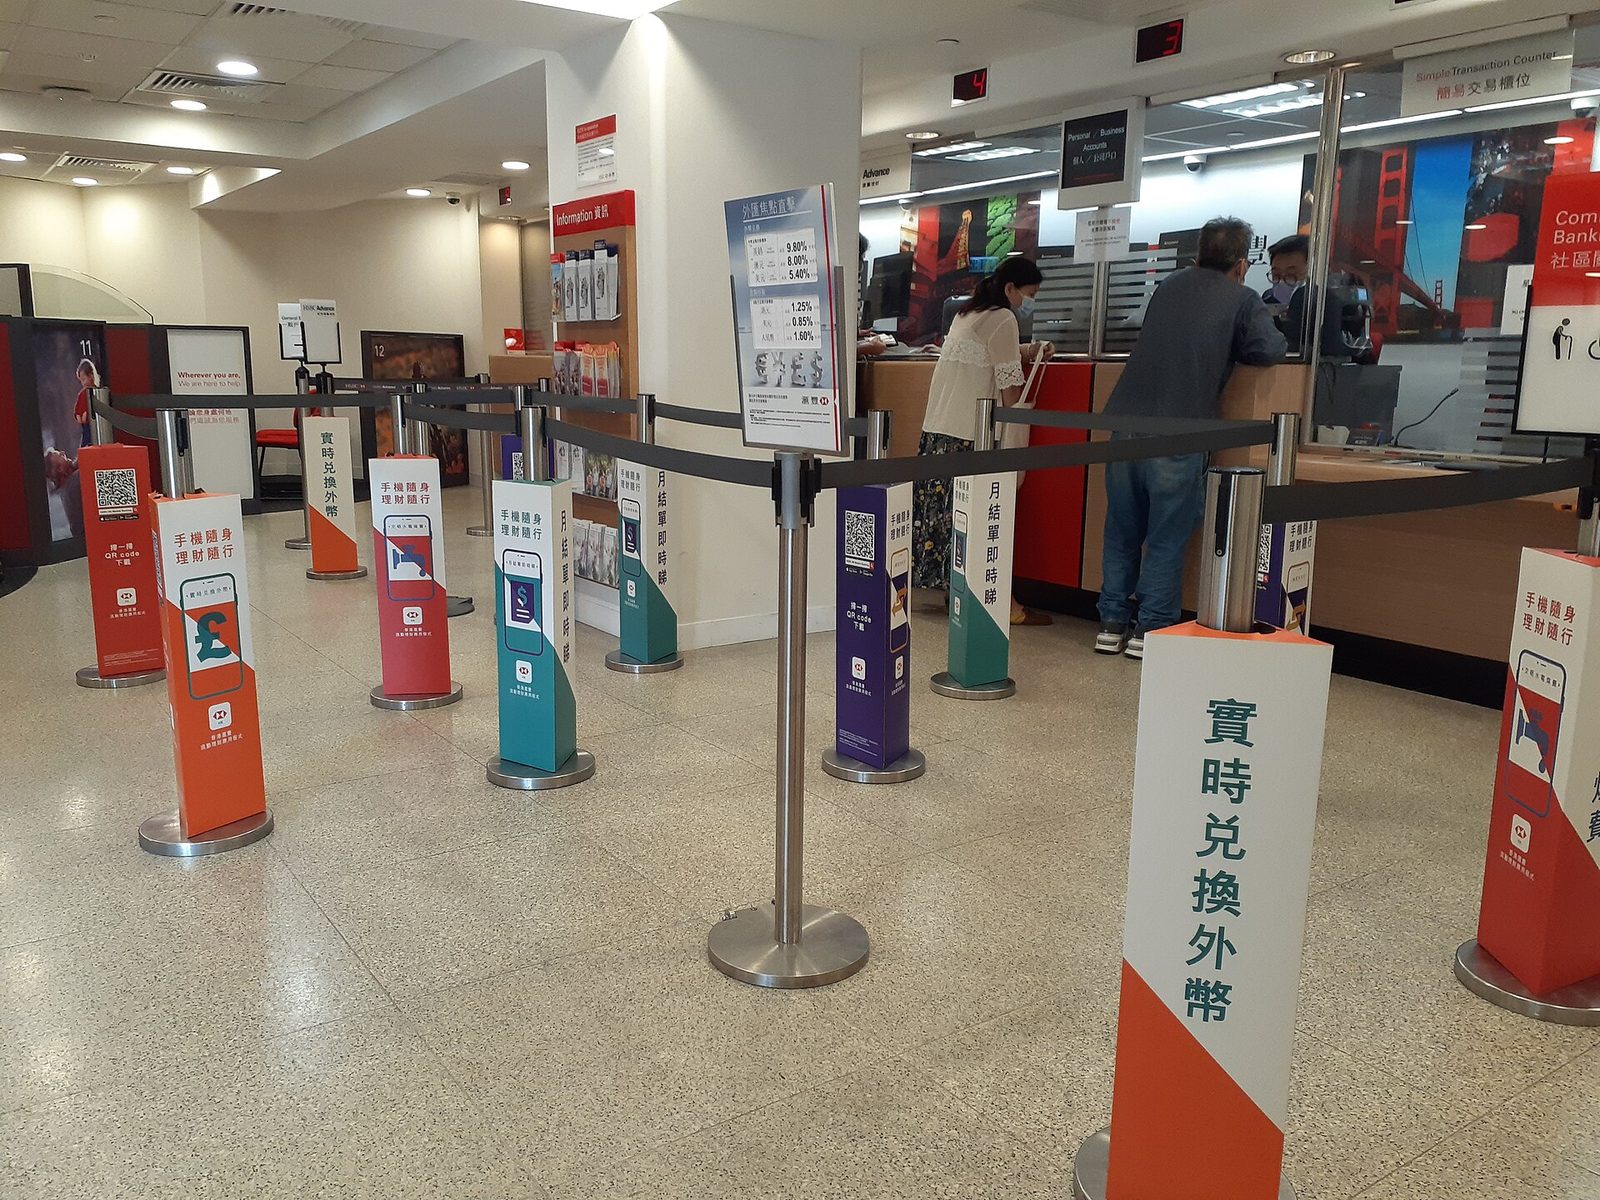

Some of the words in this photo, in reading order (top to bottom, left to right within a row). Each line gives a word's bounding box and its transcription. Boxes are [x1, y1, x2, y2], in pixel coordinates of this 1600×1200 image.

[1162, 21, 1182, 55] 3
[1416, 69, 1450, 83] Simple
[1452, 59, 1510, 76] Transaction
[1513, 50, 1557, 65] Counter
[973, 70, 986, 96] 4
[1436, 73, 1531, 101] 簡易交易櫃位
[1067, 130, 1091, 142] Personal
[1100, 126, 1125, 138] Business
[1082, 141, 1108, 152] Accounts
[862, 168, 890, 179] Advance
[556, 209, 593, 226] Information
[594, 204, 609, 219] 資訊
[742, 196, 796, 219] 外匯焦點直擊
[1556, 210, 1600, 226] Com
[786, 241, 808, 254] 9.80%
[787, 254, 808, 267] 8.00%
[789, 268, 811, 280] 5.40%
[791, 301, 813, 312] 1.25%
[792, 315, 813, 327] 0.85%
[793, 330, 814, 341] 1.60%
[80, 340, 92, 356] 11
[374, 345, 385, 357] 12
[177, 371, 212, 379] Wherever
[213, 372, 227, 380] you
[227, 380, 241, 388] help
[320, 432, 338, 518] 實時兌換外幣
[380, 481, 430, 493] 手機隨身
[381, 494, 431, 505] 理財隨行
[500, 508, 542, 526] 手機隨身
[500, 523, 542, 541] 理財隨行
[657, 471, 667, 586] 月結單即時睇
[174, 527, 233, 548] 手機隨身
[984, 481, 1001, 605] 月結單即時睇
[1289, 535, 1312, 553] 理財隨行
[104, 551, 119, 560] QR
[121, 550, 140, 559] code
[175, 544, 234, 566] 理財隨行
[1525, 590, 1576, 624] 手機隨身
[846, 610, 856, 620] QR
[857, 613, 872, 624] code
[1522, 612, 1573, 646] 理財隨行
[1184, 698, 1258, 1022] 實時兌換外幣
